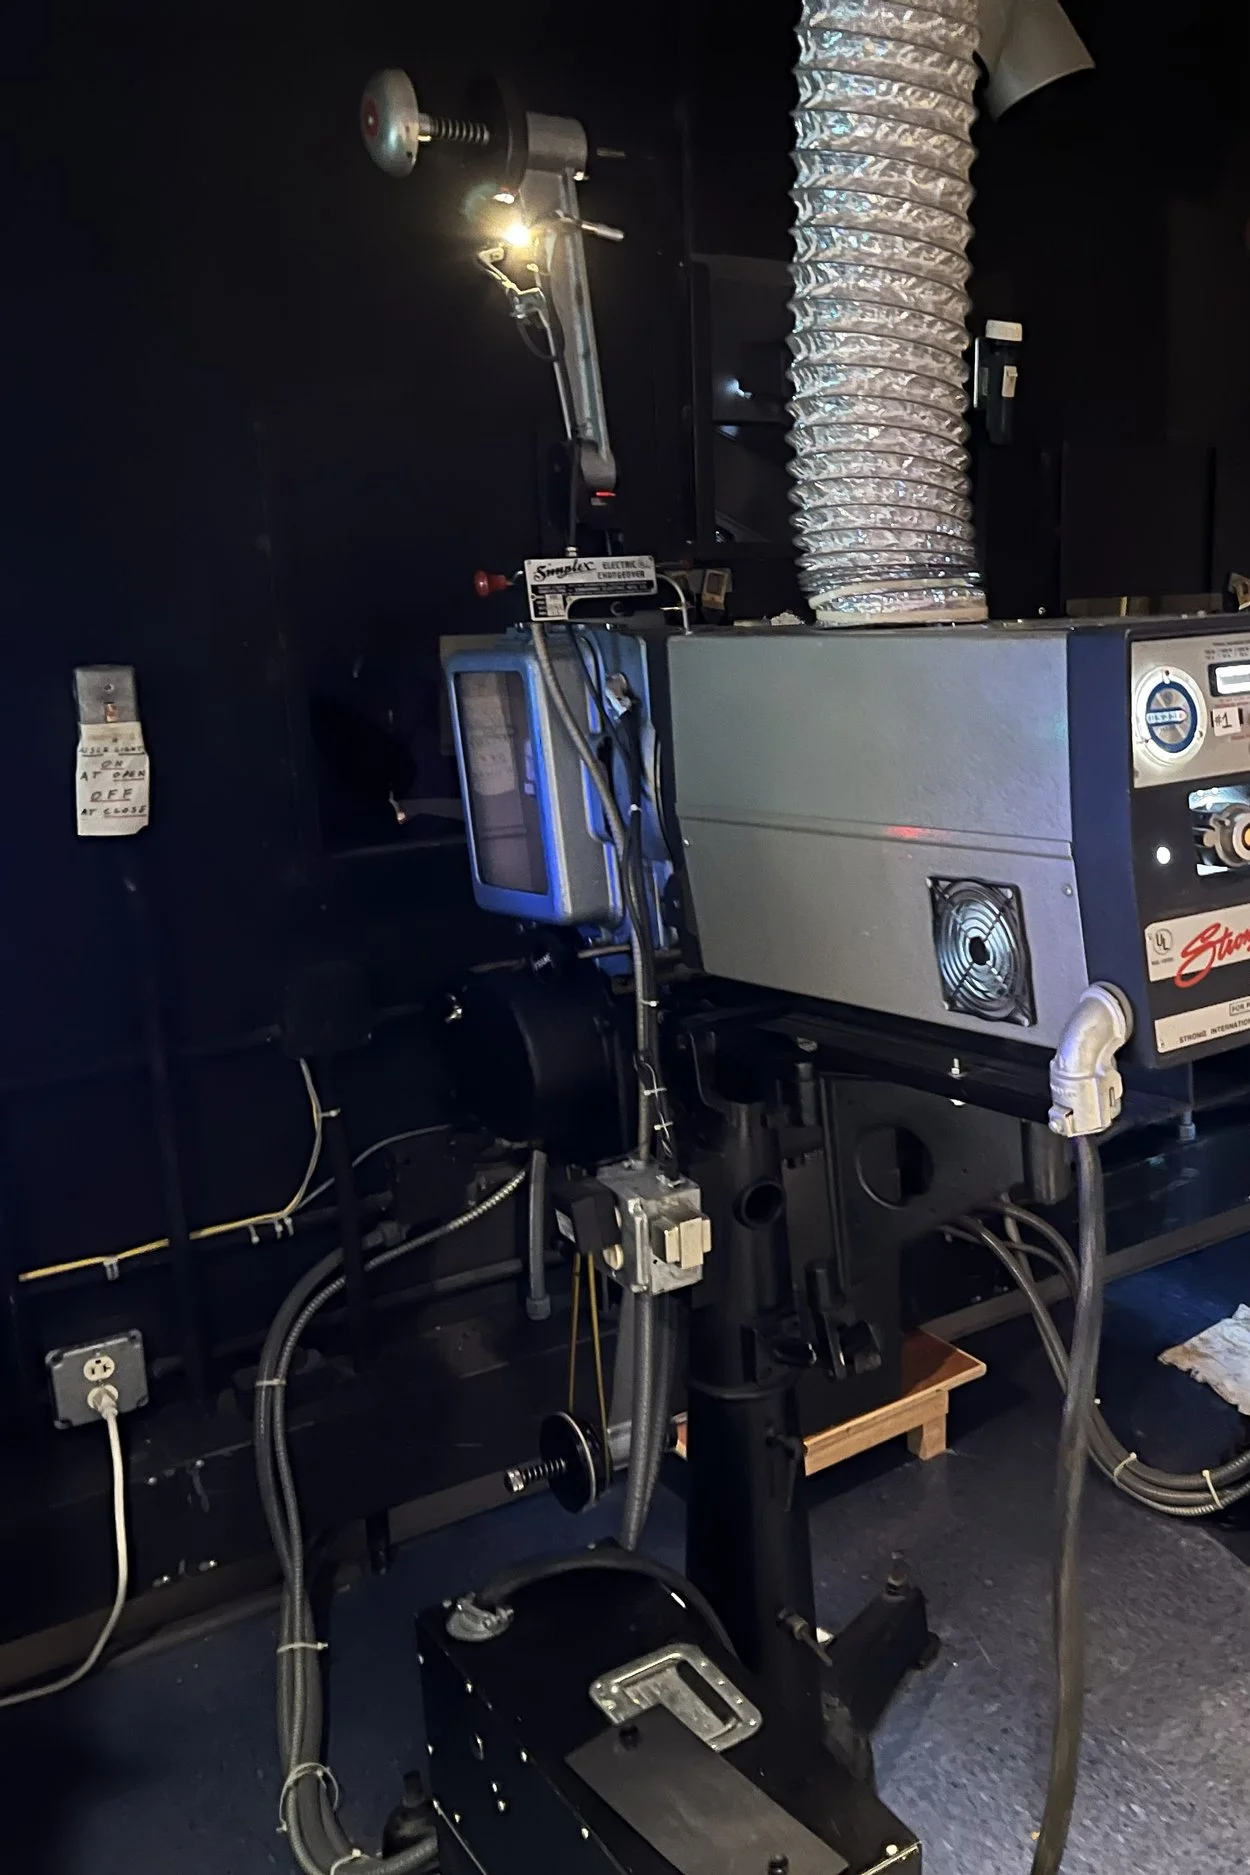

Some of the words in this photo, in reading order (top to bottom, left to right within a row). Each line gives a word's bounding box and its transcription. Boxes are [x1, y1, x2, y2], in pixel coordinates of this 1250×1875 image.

[533, 559, 597, 582] Simplex
[602, 560, 637, 570] ELECTRIC
[1214, 711, 1233, 729] #1
[100, 760, 124, 769] ON
[80, 771, 102, 781] AT
[112, 769, 145, 779] OPEN
[90, 788, 133, 801] OFF
[103, 804, 147, 815] CLOSE
[1231, 1003, 1245, 1013] FOR
[1179, 1030, 1207, 1044] STRONG
